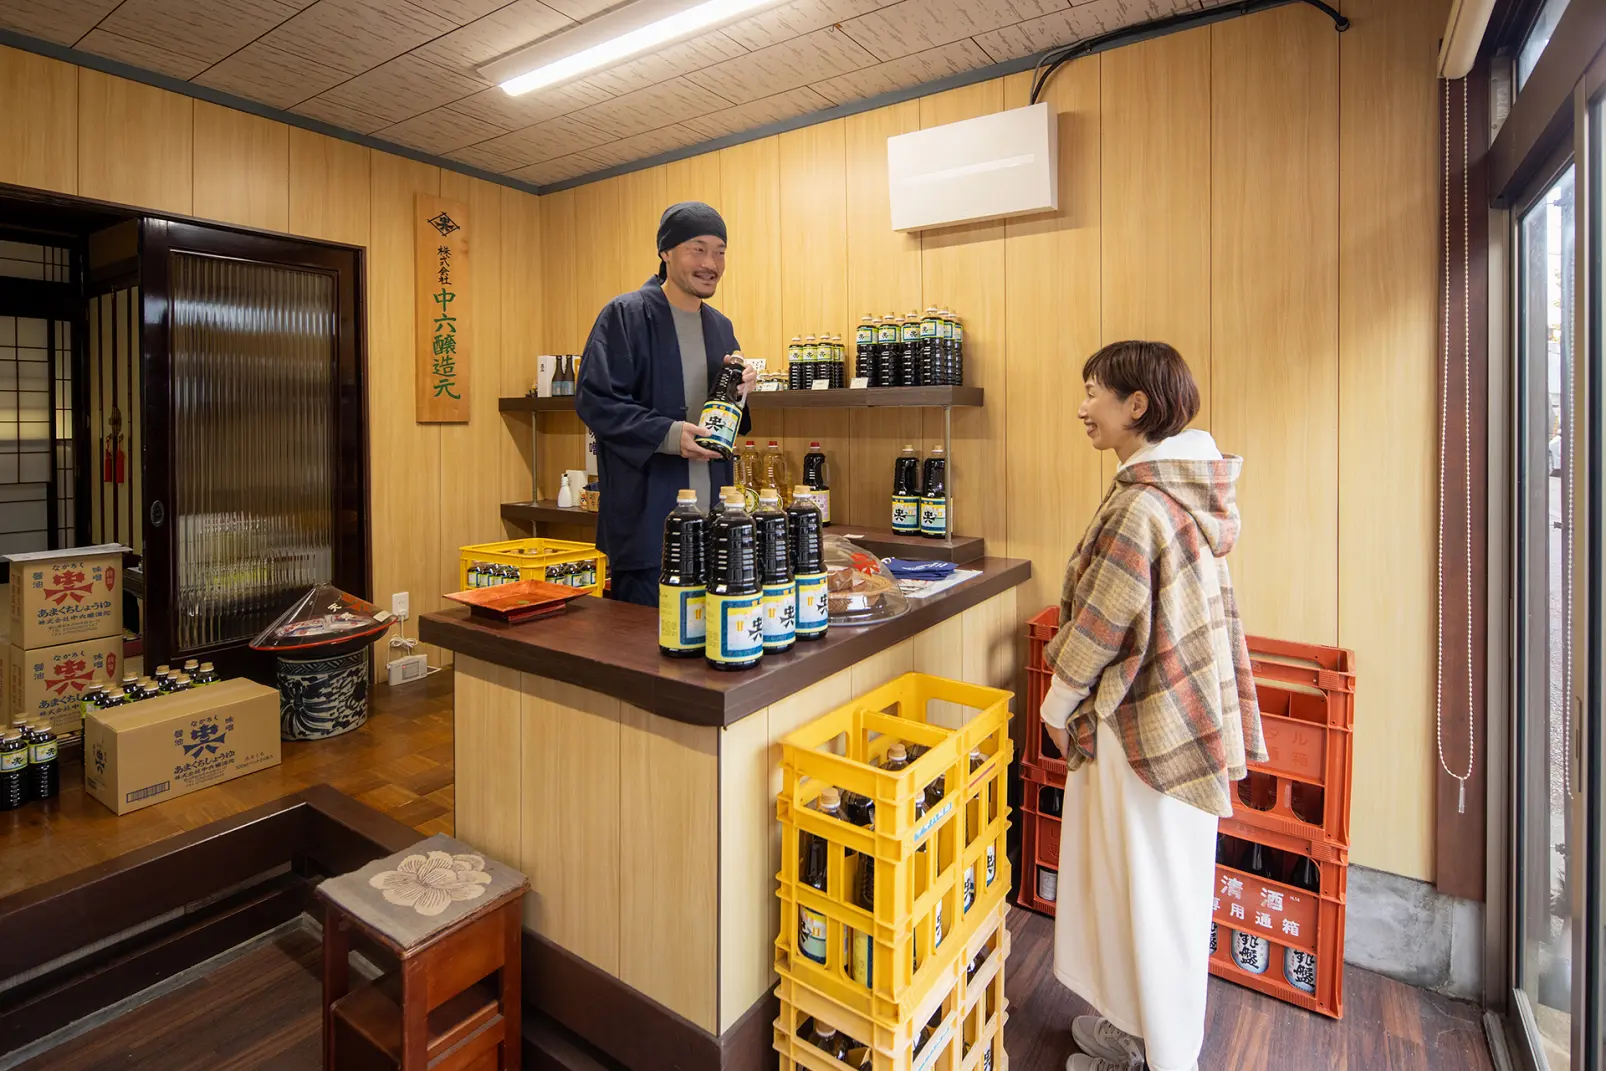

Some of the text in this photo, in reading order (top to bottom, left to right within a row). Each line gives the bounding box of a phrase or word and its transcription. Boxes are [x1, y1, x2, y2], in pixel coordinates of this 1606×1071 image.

[437, 244, 452, 286] 株式会社
[52, 562, 84, 572] なかろく
[38, 600, 112, 618] あまくちしょうゆ
[54, 650, 85, 661] なかろく
[190, 714, 218, 727] なかろく
[174, 750, 236, 774] あまくちしょうゆ
[1221, 874, 1284, 912] 清酒
